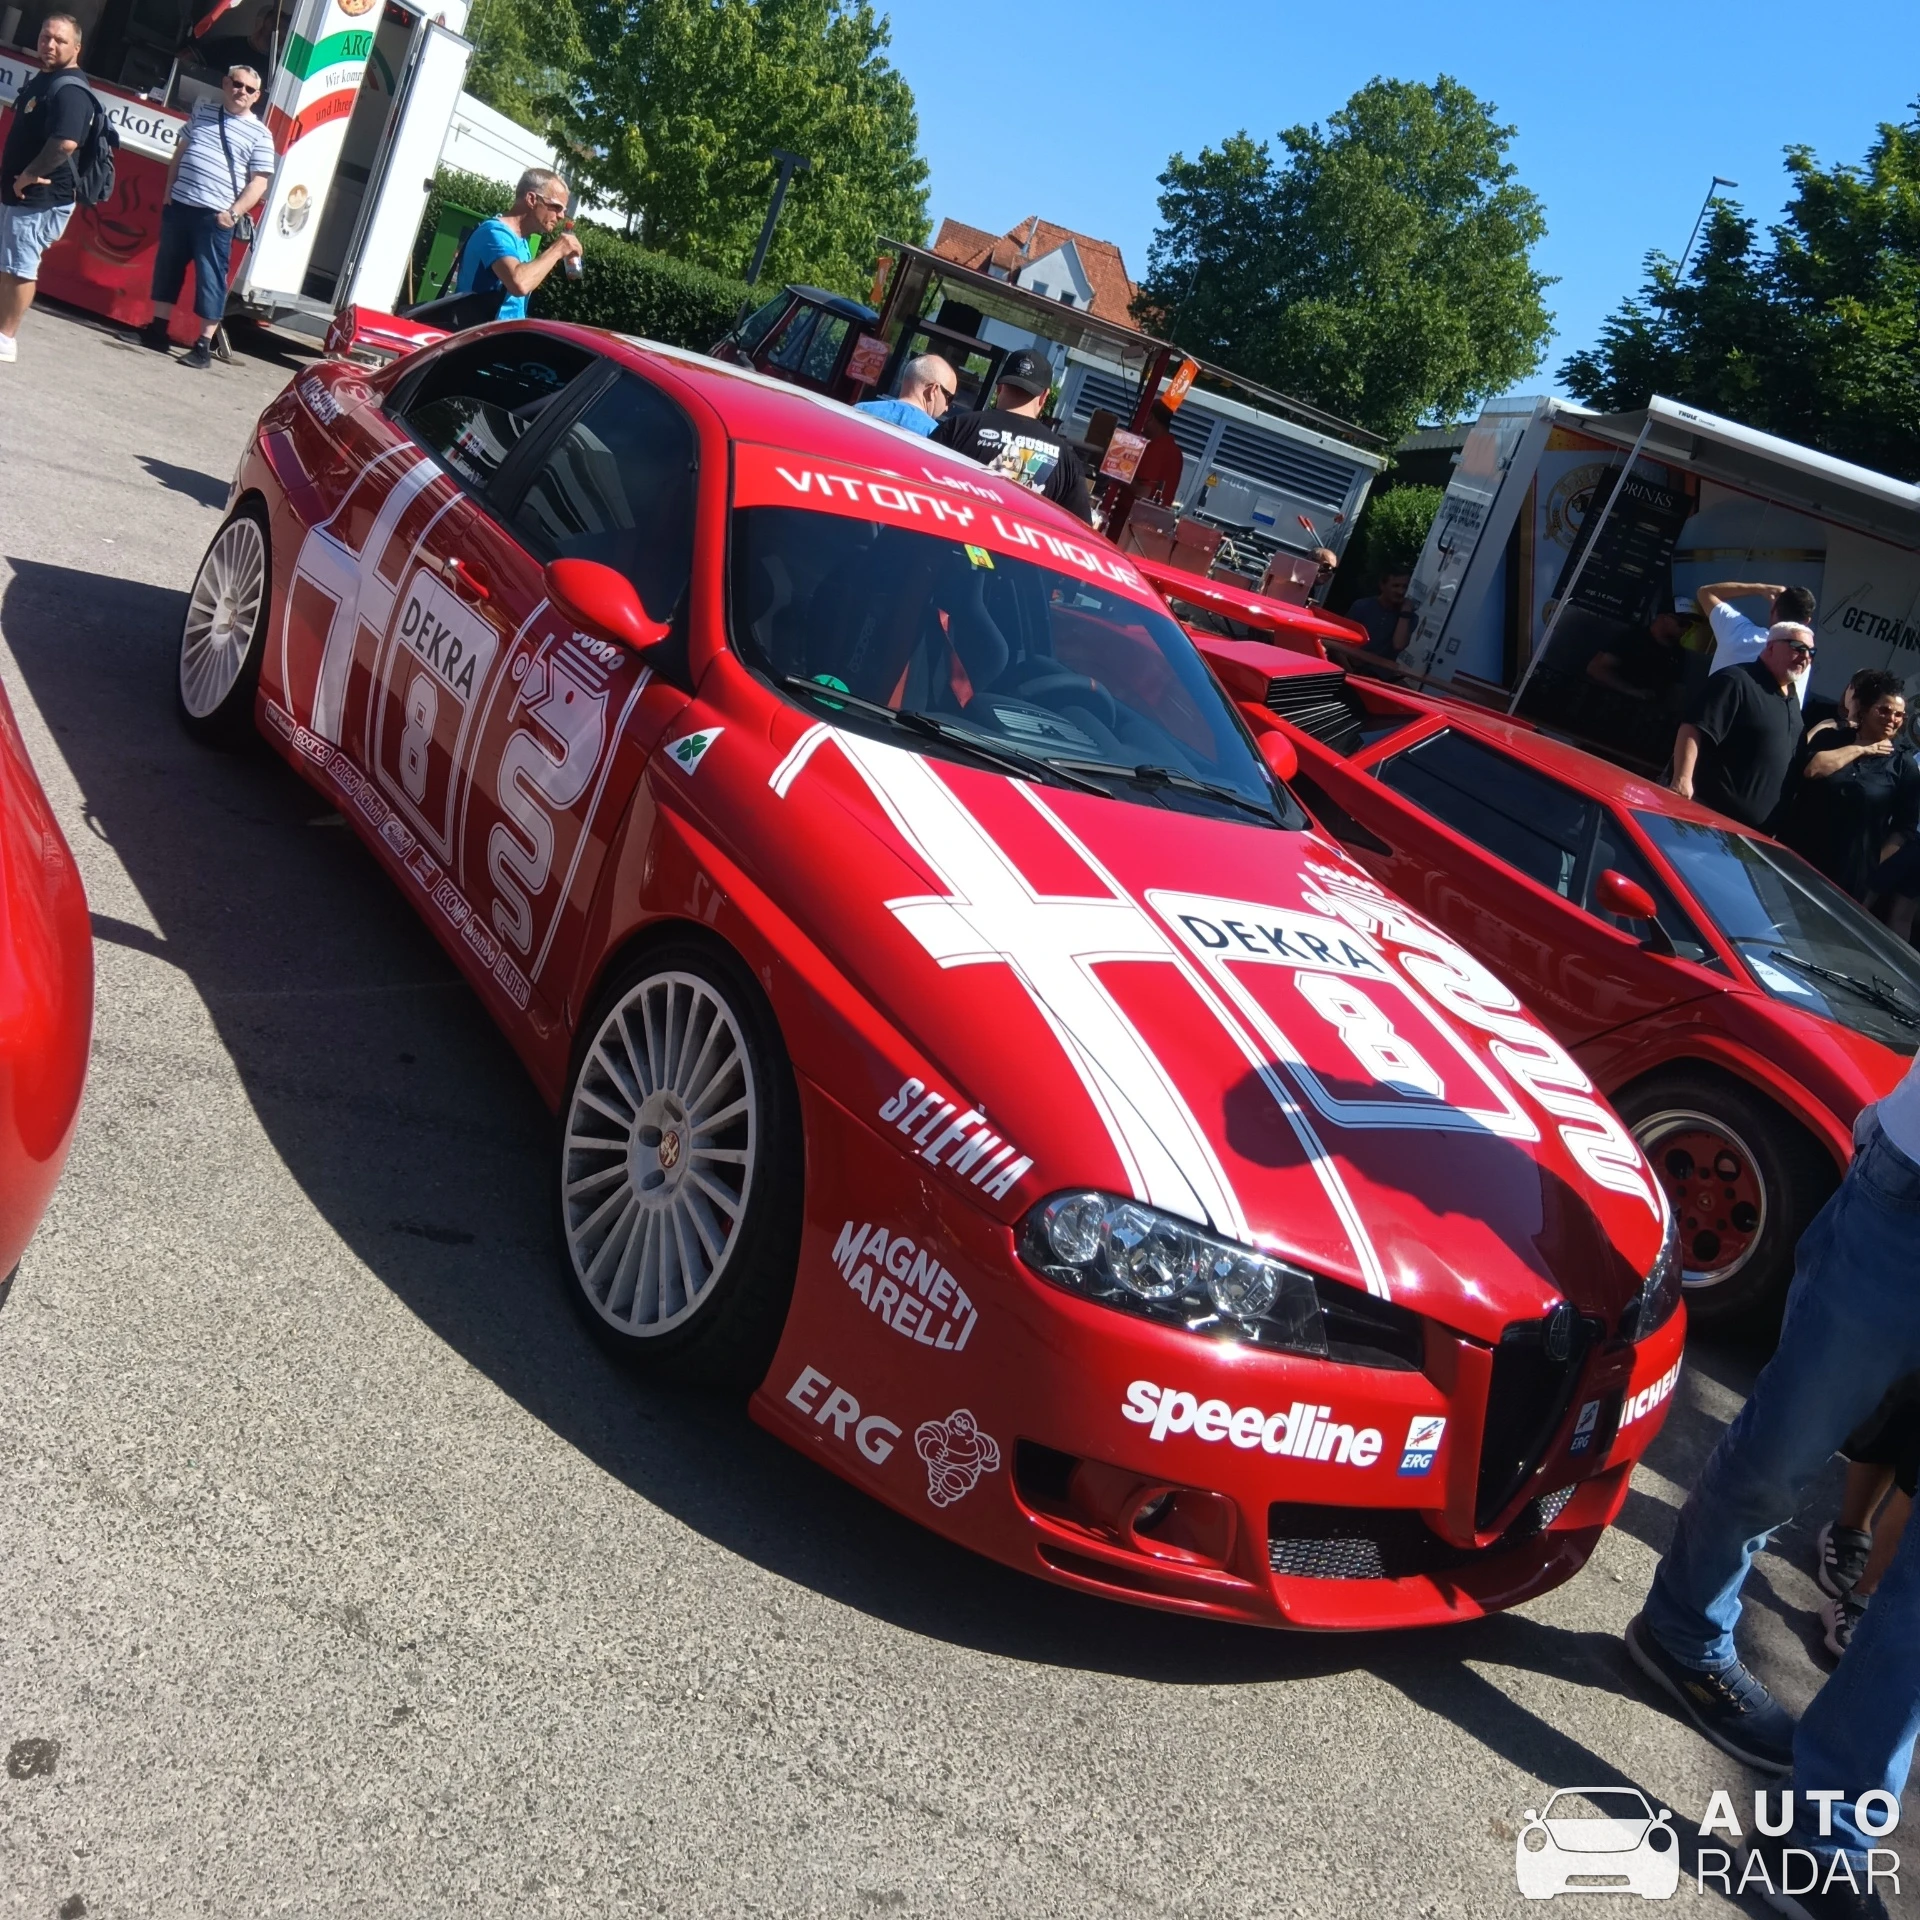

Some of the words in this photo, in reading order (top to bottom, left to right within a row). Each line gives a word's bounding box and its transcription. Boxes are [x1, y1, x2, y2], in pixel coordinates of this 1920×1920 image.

[1678, 409, 1698, 421] THULE
[920, 466, 1004, 504] Larini
[1620, 481, 1674, 509] DRINKS
[775, 466, 975, 527] VITONY
[991, 514, 1150, 596] UNIQUE
[401, 596, 477, 700] DEKRA
[295, 730, 331, 761] sparco
[401, 672, 439, 805] 8
[331, 758, 360, 790] soteco
[436, 884, 469, 923] CECOMP
[464, 919, 495, 963] brembo
[1177, 914, 1386, 975] DEKRA
[496, 957, 530, 1006] BILSTEIN
[1293, 970, 1446, 1100] 8
[878, 1077, 1034, 1201] SELENIA
[831, 1245, 978, 1352] MARELLI
[785, 1365, 903, 1466] ERG
[1121, 1379, 1383, 1467] speedline
[1400, 1453, 1433, 1469] ERG
[1570, 1435, 1591, 1451] ERG
